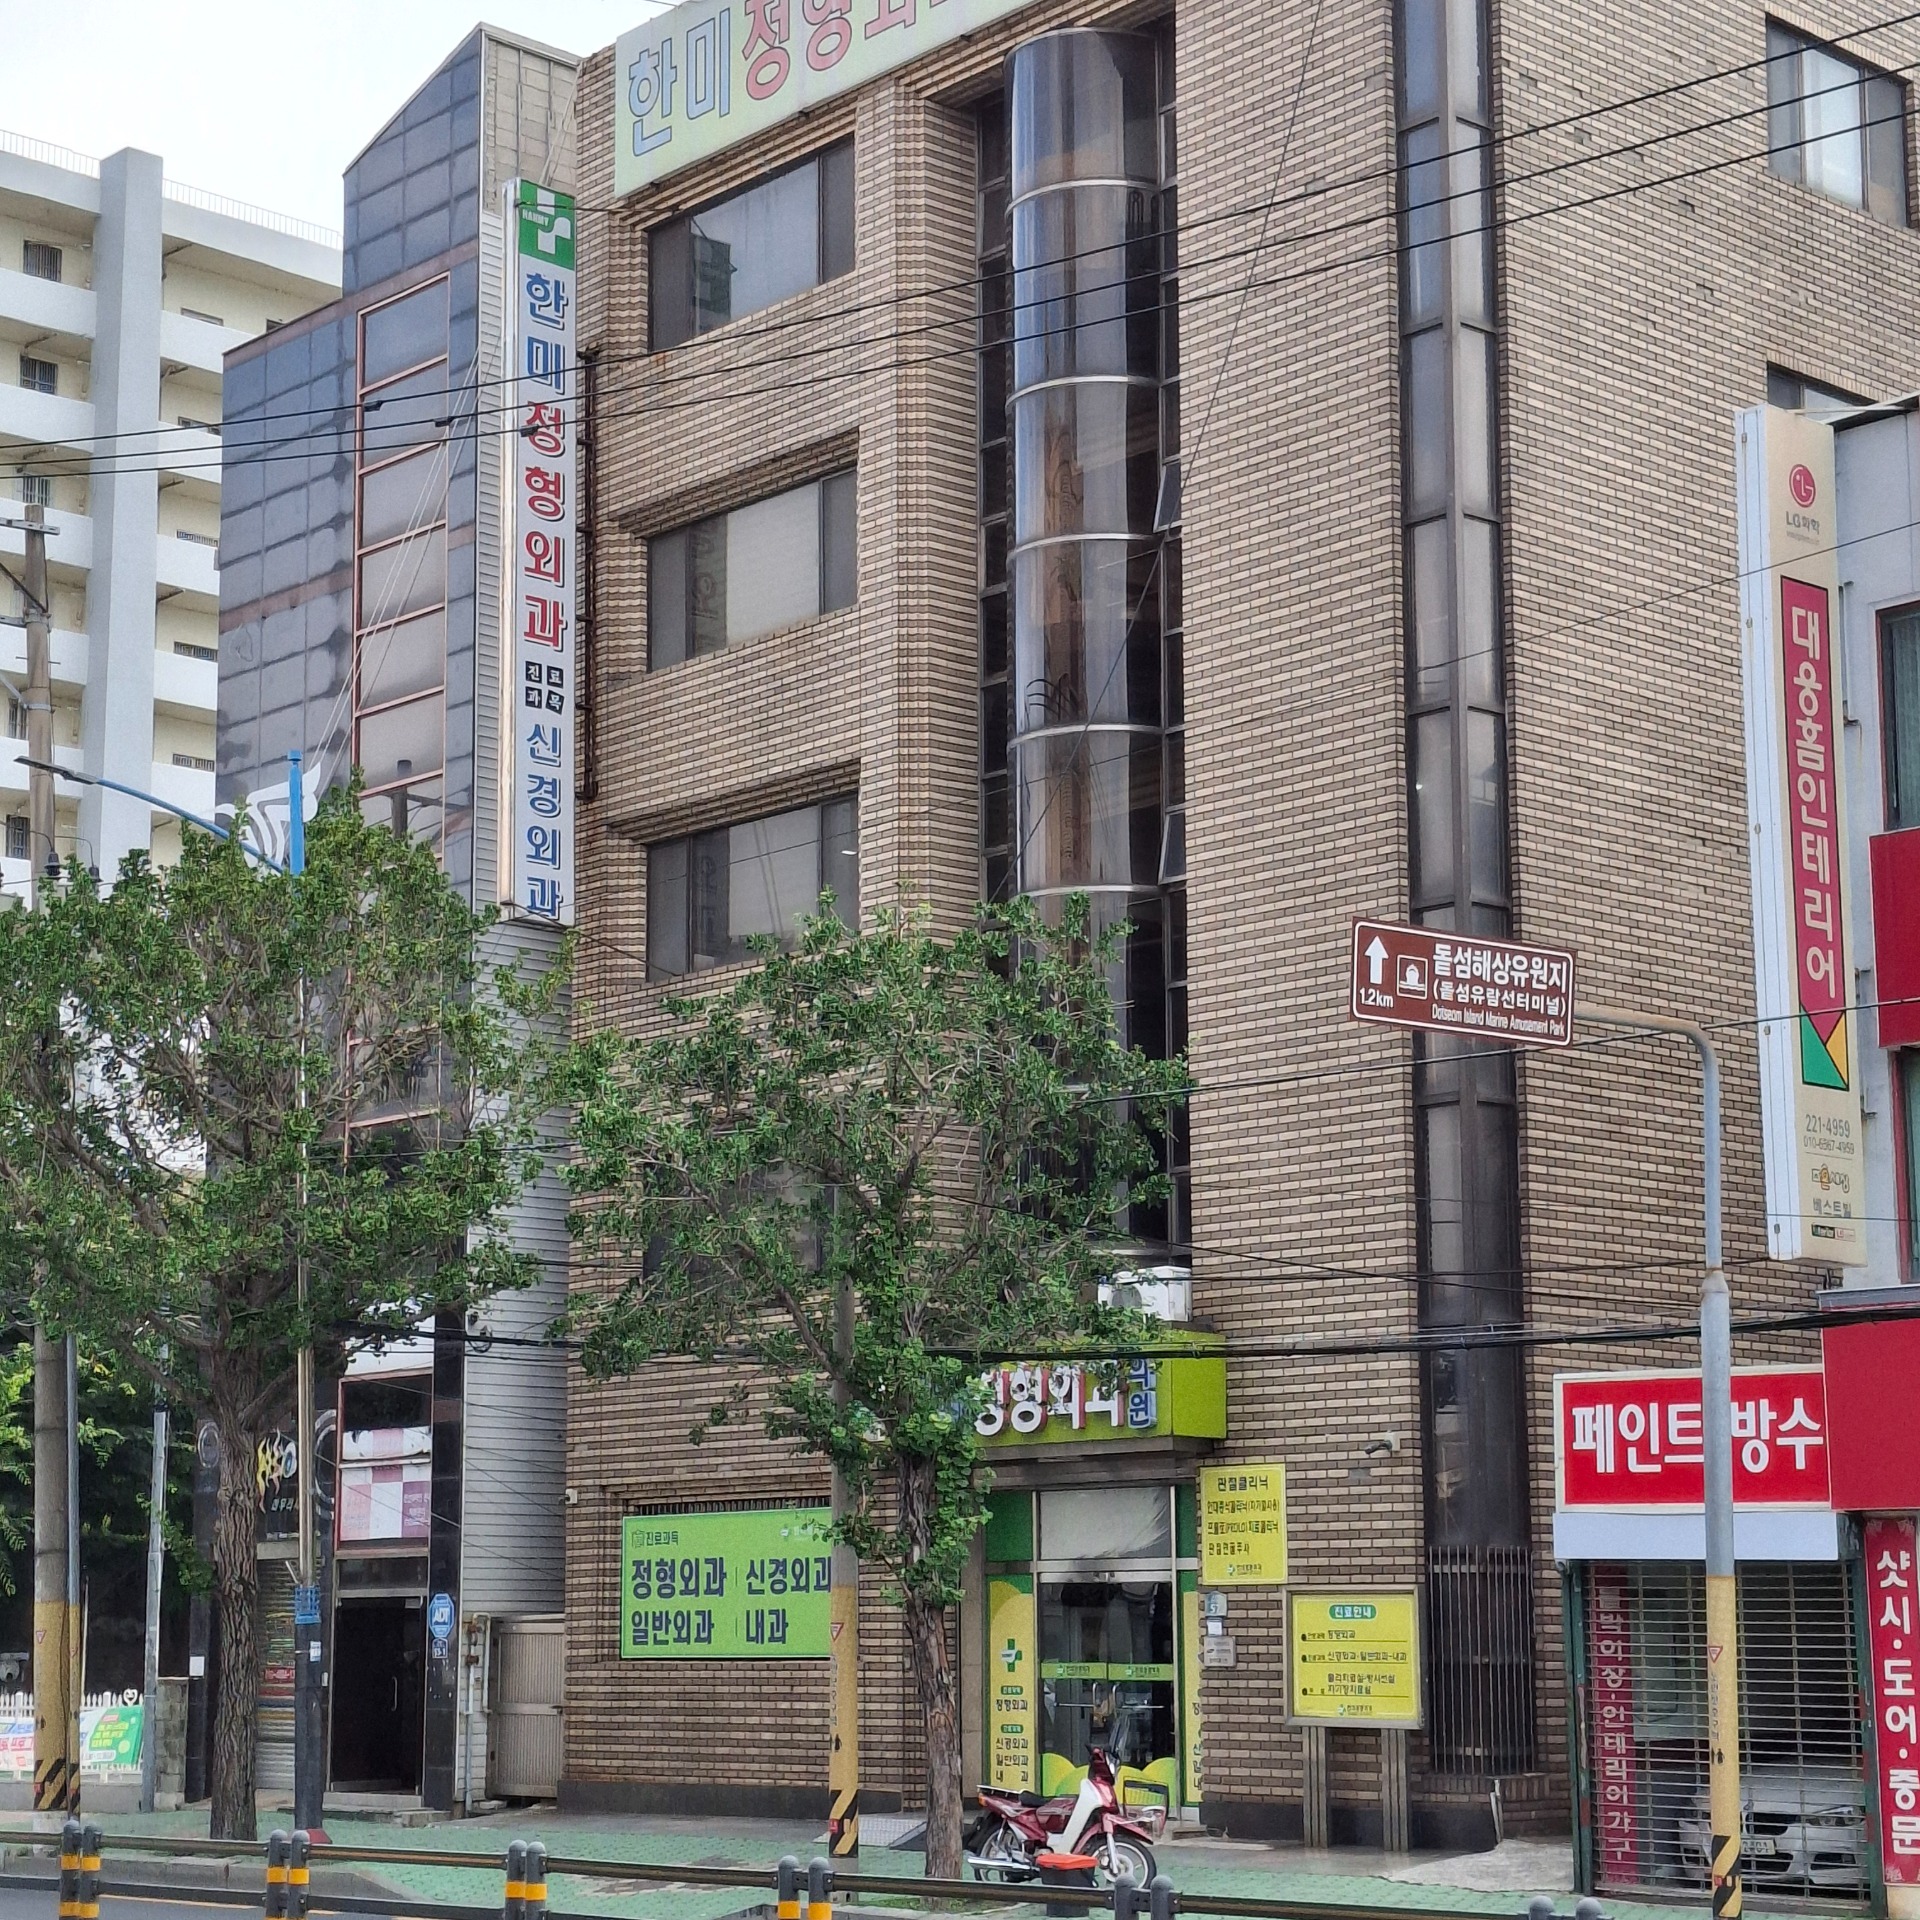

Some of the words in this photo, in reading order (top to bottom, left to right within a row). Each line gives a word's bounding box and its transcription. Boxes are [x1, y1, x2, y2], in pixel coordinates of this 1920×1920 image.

[525, 723, 562, 920] 신경외과
[1432, 943, 1567, 993] 돝섬해상유원지
[1464, 1007, 1484, 1025] Island
[1486, 1010, 1508, 1029] Marine
[1510, 1015, 1548, 1034] Amusement
[1549, 1019, 1565, 1037] Park
[1571, 1402, 1704, 1473] 페인트
[1731, 1398, 1824, 1473] 방수
[631, 1557, 727, 1599] 정형외과
[745, 1557, 831, 1595] 신경외과
[631, 1609, 714, 1646] 일반외과
[745, 1608, 788, 1645] 내과
